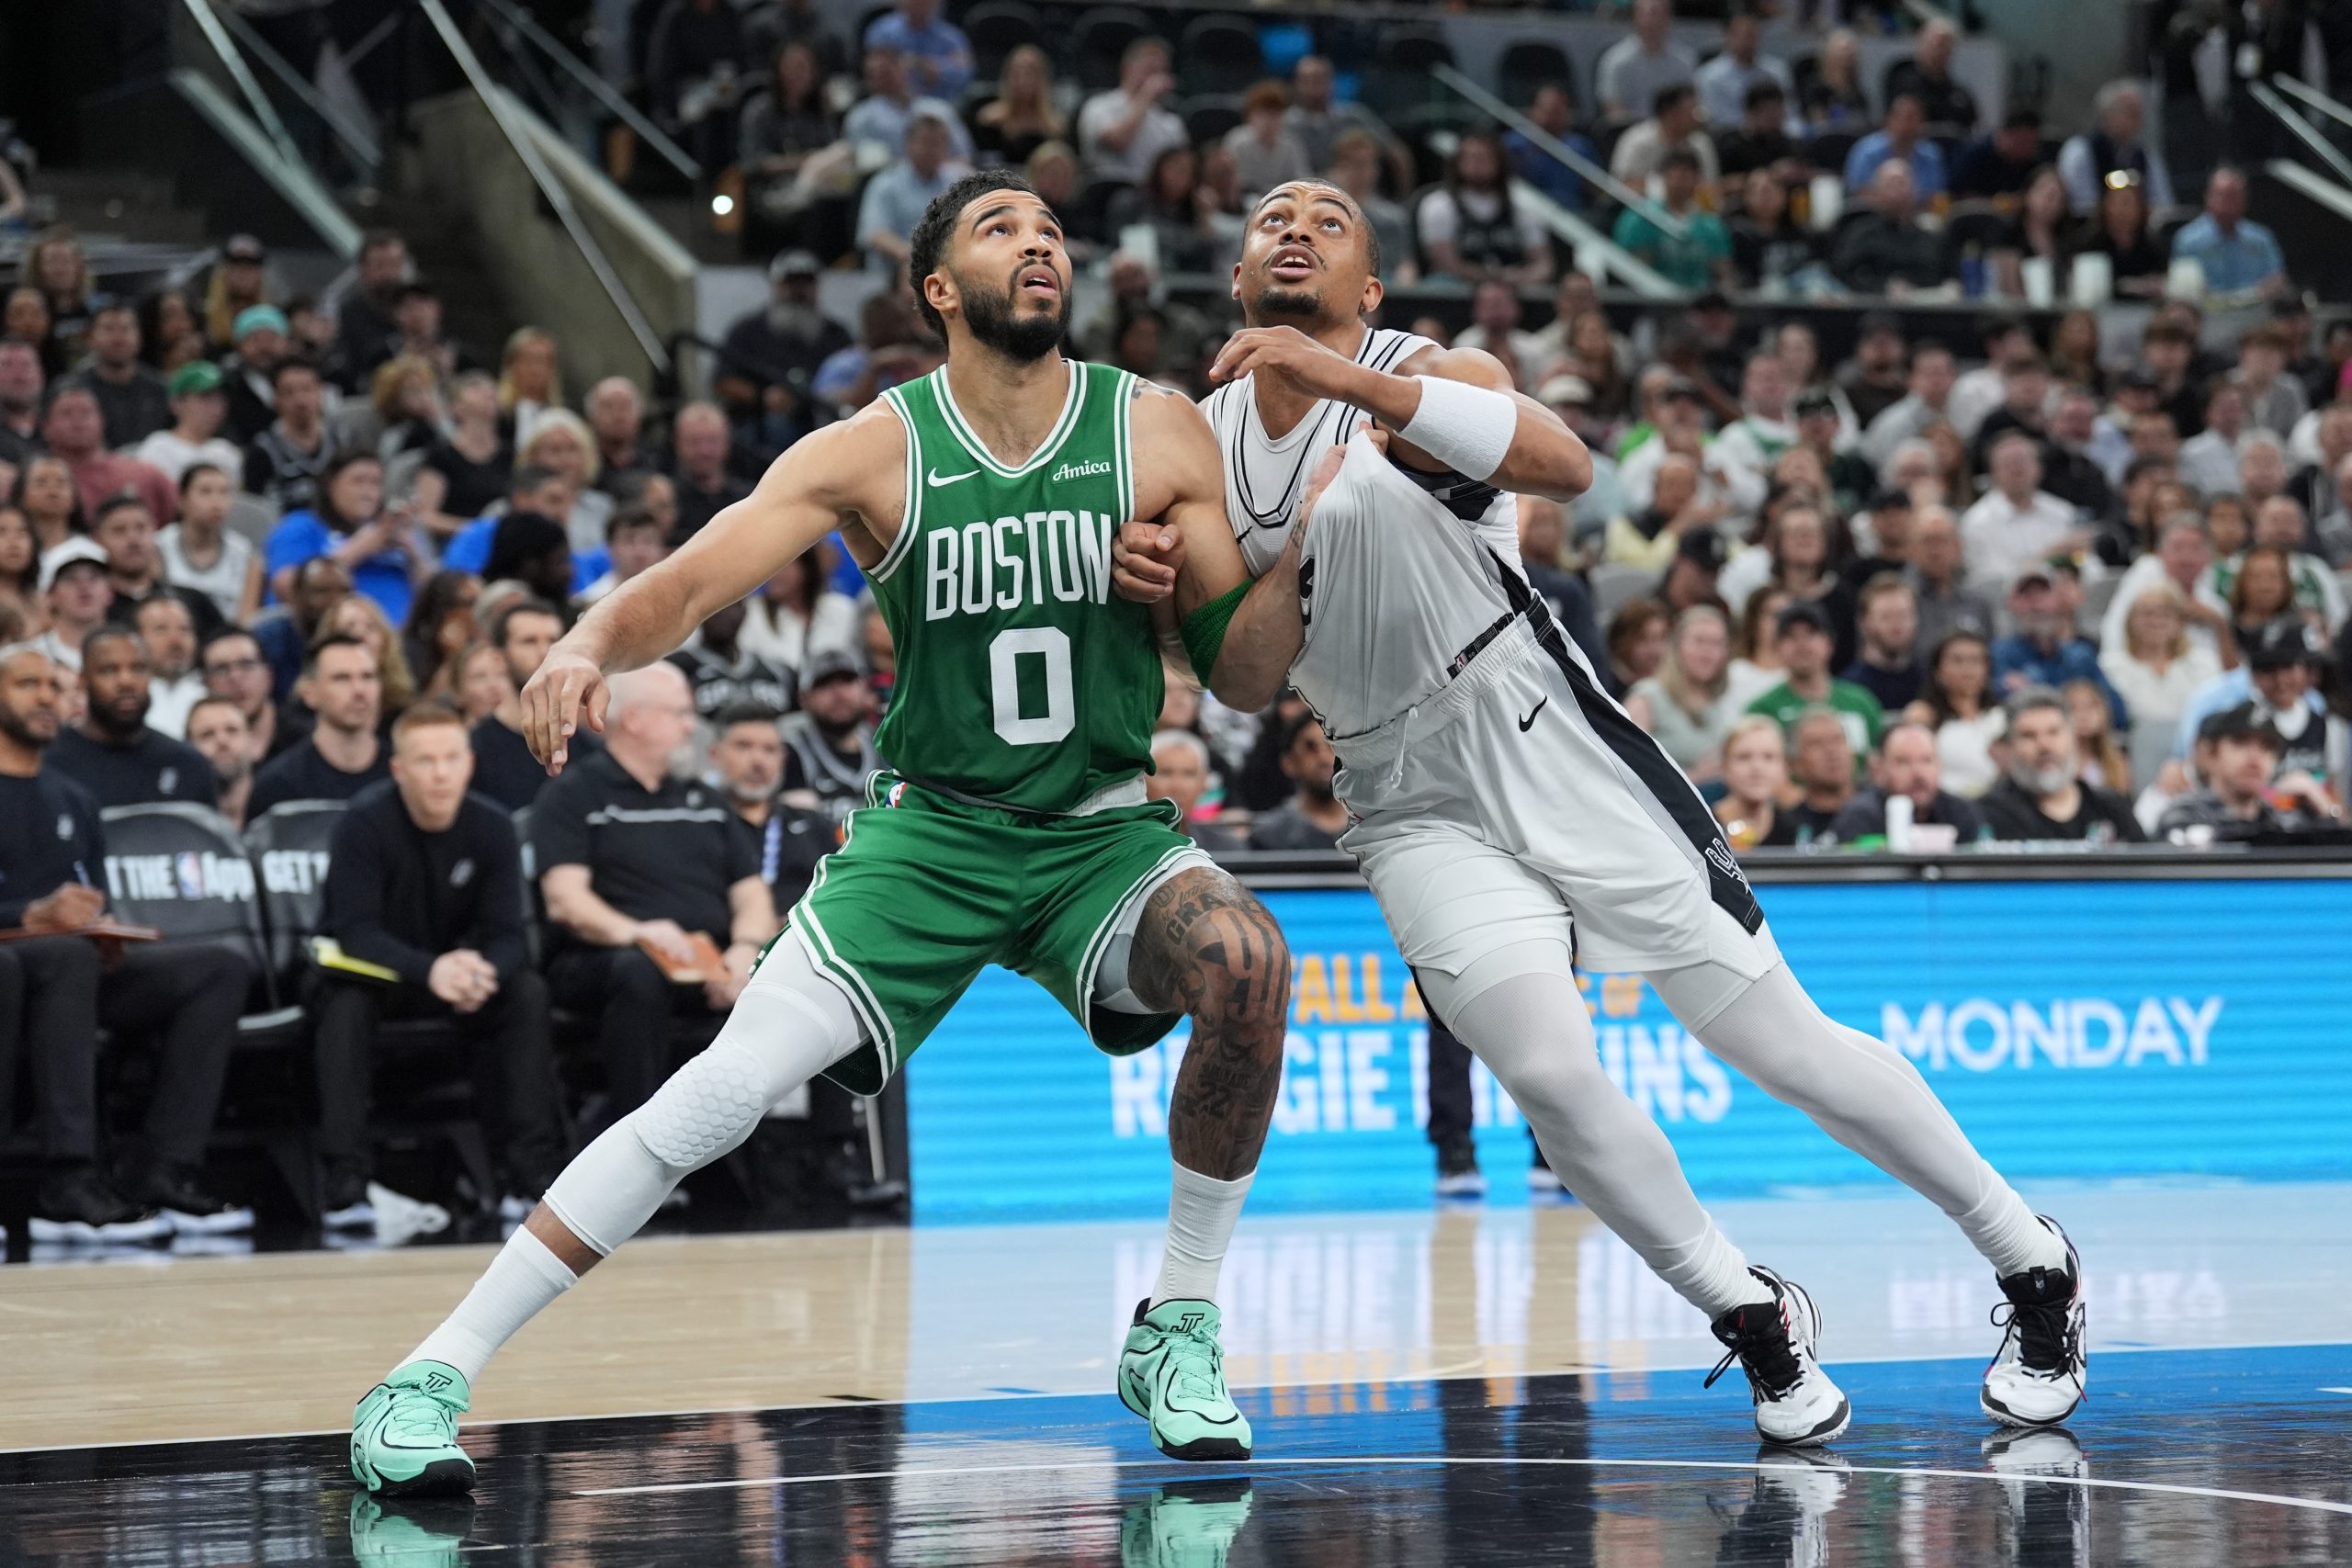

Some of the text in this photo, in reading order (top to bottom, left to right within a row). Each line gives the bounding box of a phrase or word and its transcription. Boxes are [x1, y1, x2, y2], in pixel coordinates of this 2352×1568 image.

[1052, 459, 1112, 481] Amica
[925, 509, 1112, 623] BOSTON
[989, 626, 1076, 746] 0
[120, 854, 177, 900] THE
[199, 851, 255, 903] App
[261, 850, 311, 895] GET
[1289, 953, 1396, 1022] ALL
[1880, 996, 2224, 1072] MONDAY
[1110, 1028, 1396, 1137] RGIE
